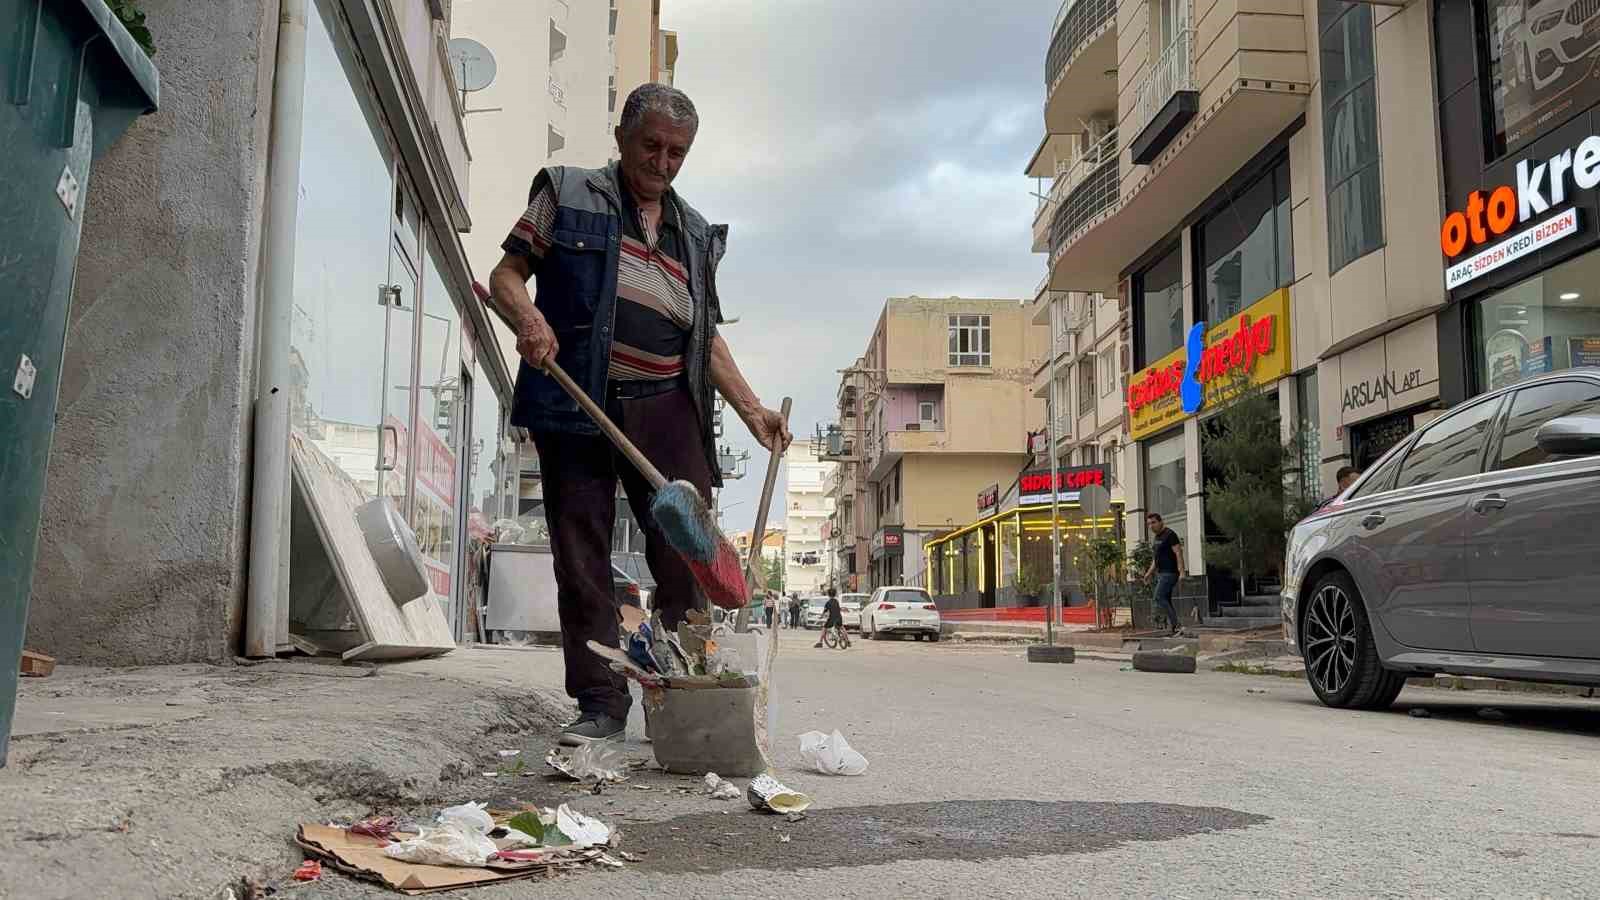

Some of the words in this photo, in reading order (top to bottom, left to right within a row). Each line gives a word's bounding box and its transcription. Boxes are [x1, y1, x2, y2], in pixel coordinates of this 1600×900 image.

[1450, 264, 1473, 283] ARAÇ
[1474, 247, 1505, 271] SİZDEN
[1506, 230, 1534, 257] KREDİ
[1535, 215, 1573, 242] BİZDEN
[1342, 370, 1397, 413] ARSLAN
[1402, 369, 1421, 390] APT
[1067, 469, 1105, 489] CAFE
